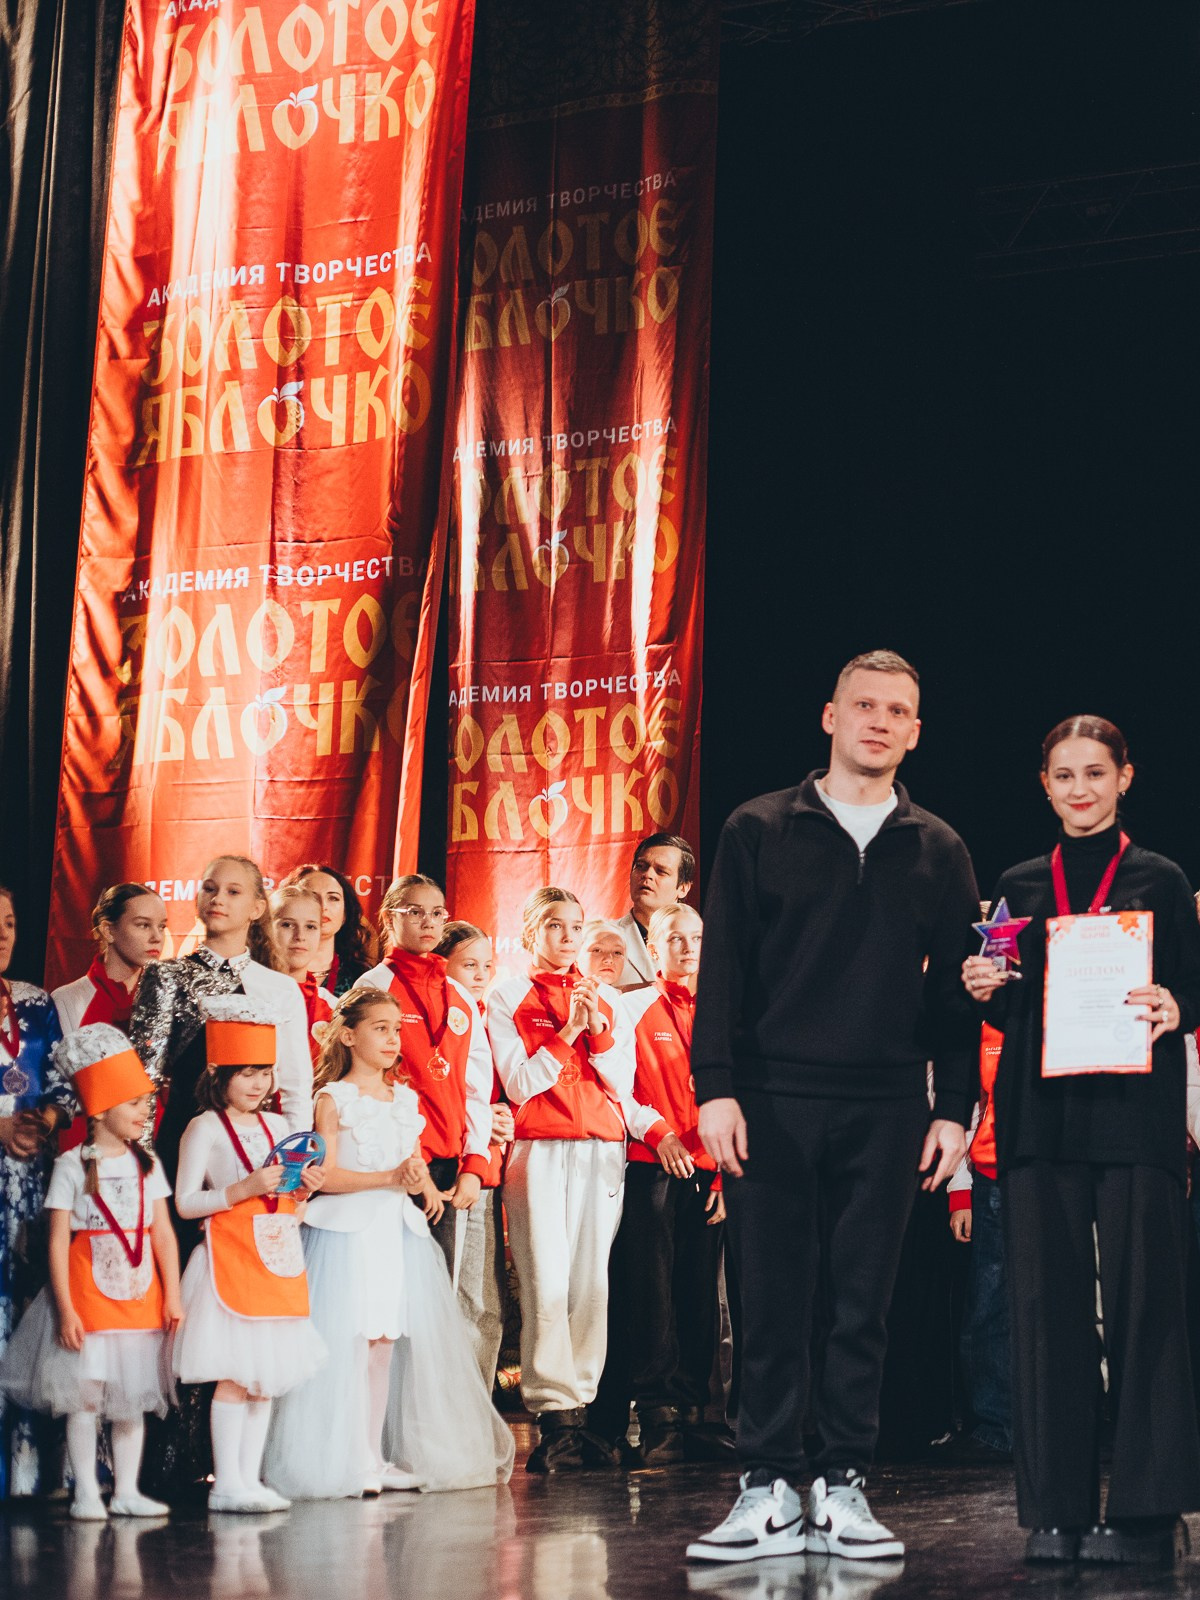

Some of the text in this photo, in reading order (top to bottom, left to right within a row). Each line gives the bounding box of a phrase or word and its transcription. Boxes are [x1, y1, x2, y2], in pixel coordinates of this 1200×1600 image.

[460, 171, 677, 223] АДЕМИЯ ТВОРЧЕСТВА
[147, 242, 432, 308] АКАДЕМИЯ ТВОРЧЕСТВА
[472, 198, 678, 288] ОЛОТОЕ
[141, 275, 433, 387] ЗОЛОТОЕ
[465, 266, 680, 352] БЛОЧКО
[135, 358, 432, 467] ЯБЛОЧКО
[452, 416, 678, 463] АДЕМИЯ ТВОРЧЕСТВА
[455, 445, 678, 525] ОЛОТОЕ
[122, 566, 250, 603] АКАДЕМИЯ
[449, 668, 681, 709] АДЕМИЯ ТВОРЧЕСТВА
[450, 697, 683, 775] ОЛОТОЕ
[451, 766, 680, 843] БЛОЧКО
